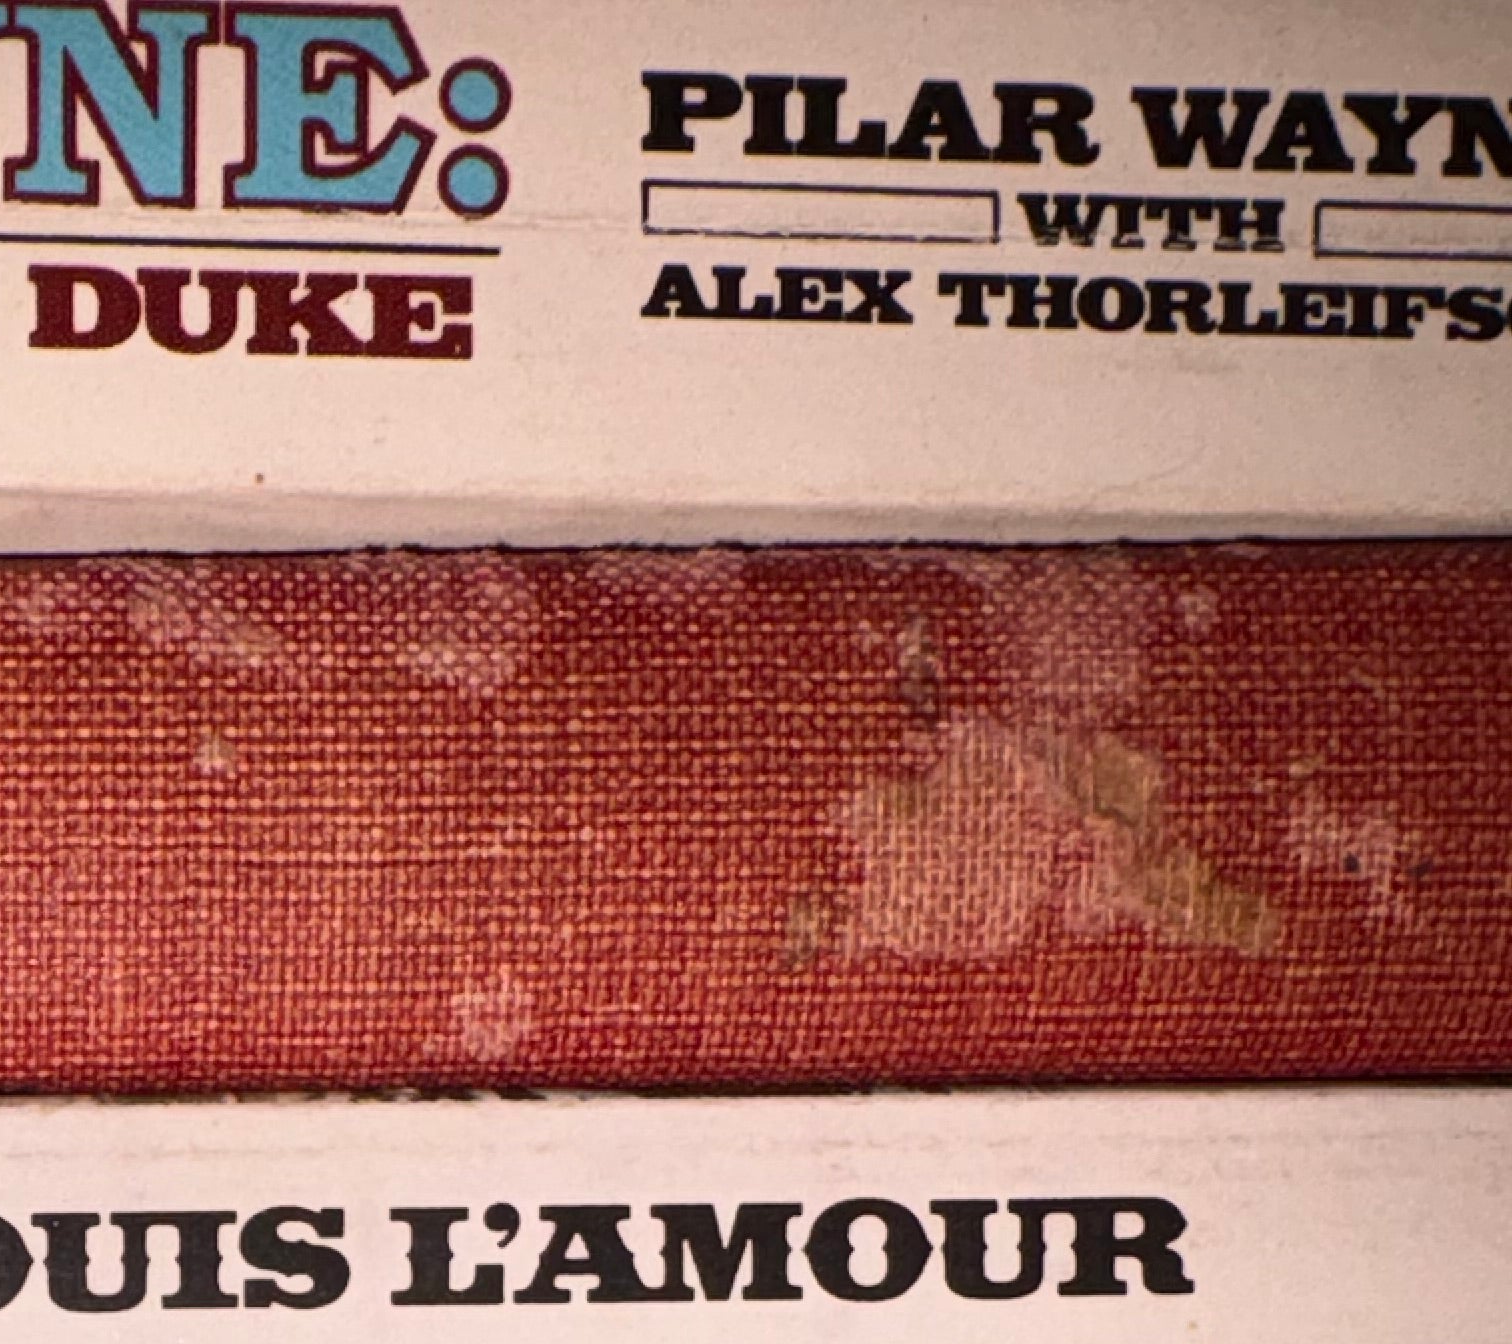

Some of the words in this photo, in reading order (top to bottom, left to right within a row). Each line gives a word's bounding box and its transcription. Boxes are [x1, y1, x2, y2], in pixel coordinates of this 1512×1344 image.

[641, 70, 1099, 165] PILAR
[1017, 193, 1285, 252] WITH
[28, 264, 472, 359] DUKE
[641, 264, 913, 324] ALEX
[938, 272, 1512, 341] THORLEIFS
[390, 1198, 1194, 1305] L'AMOUR
